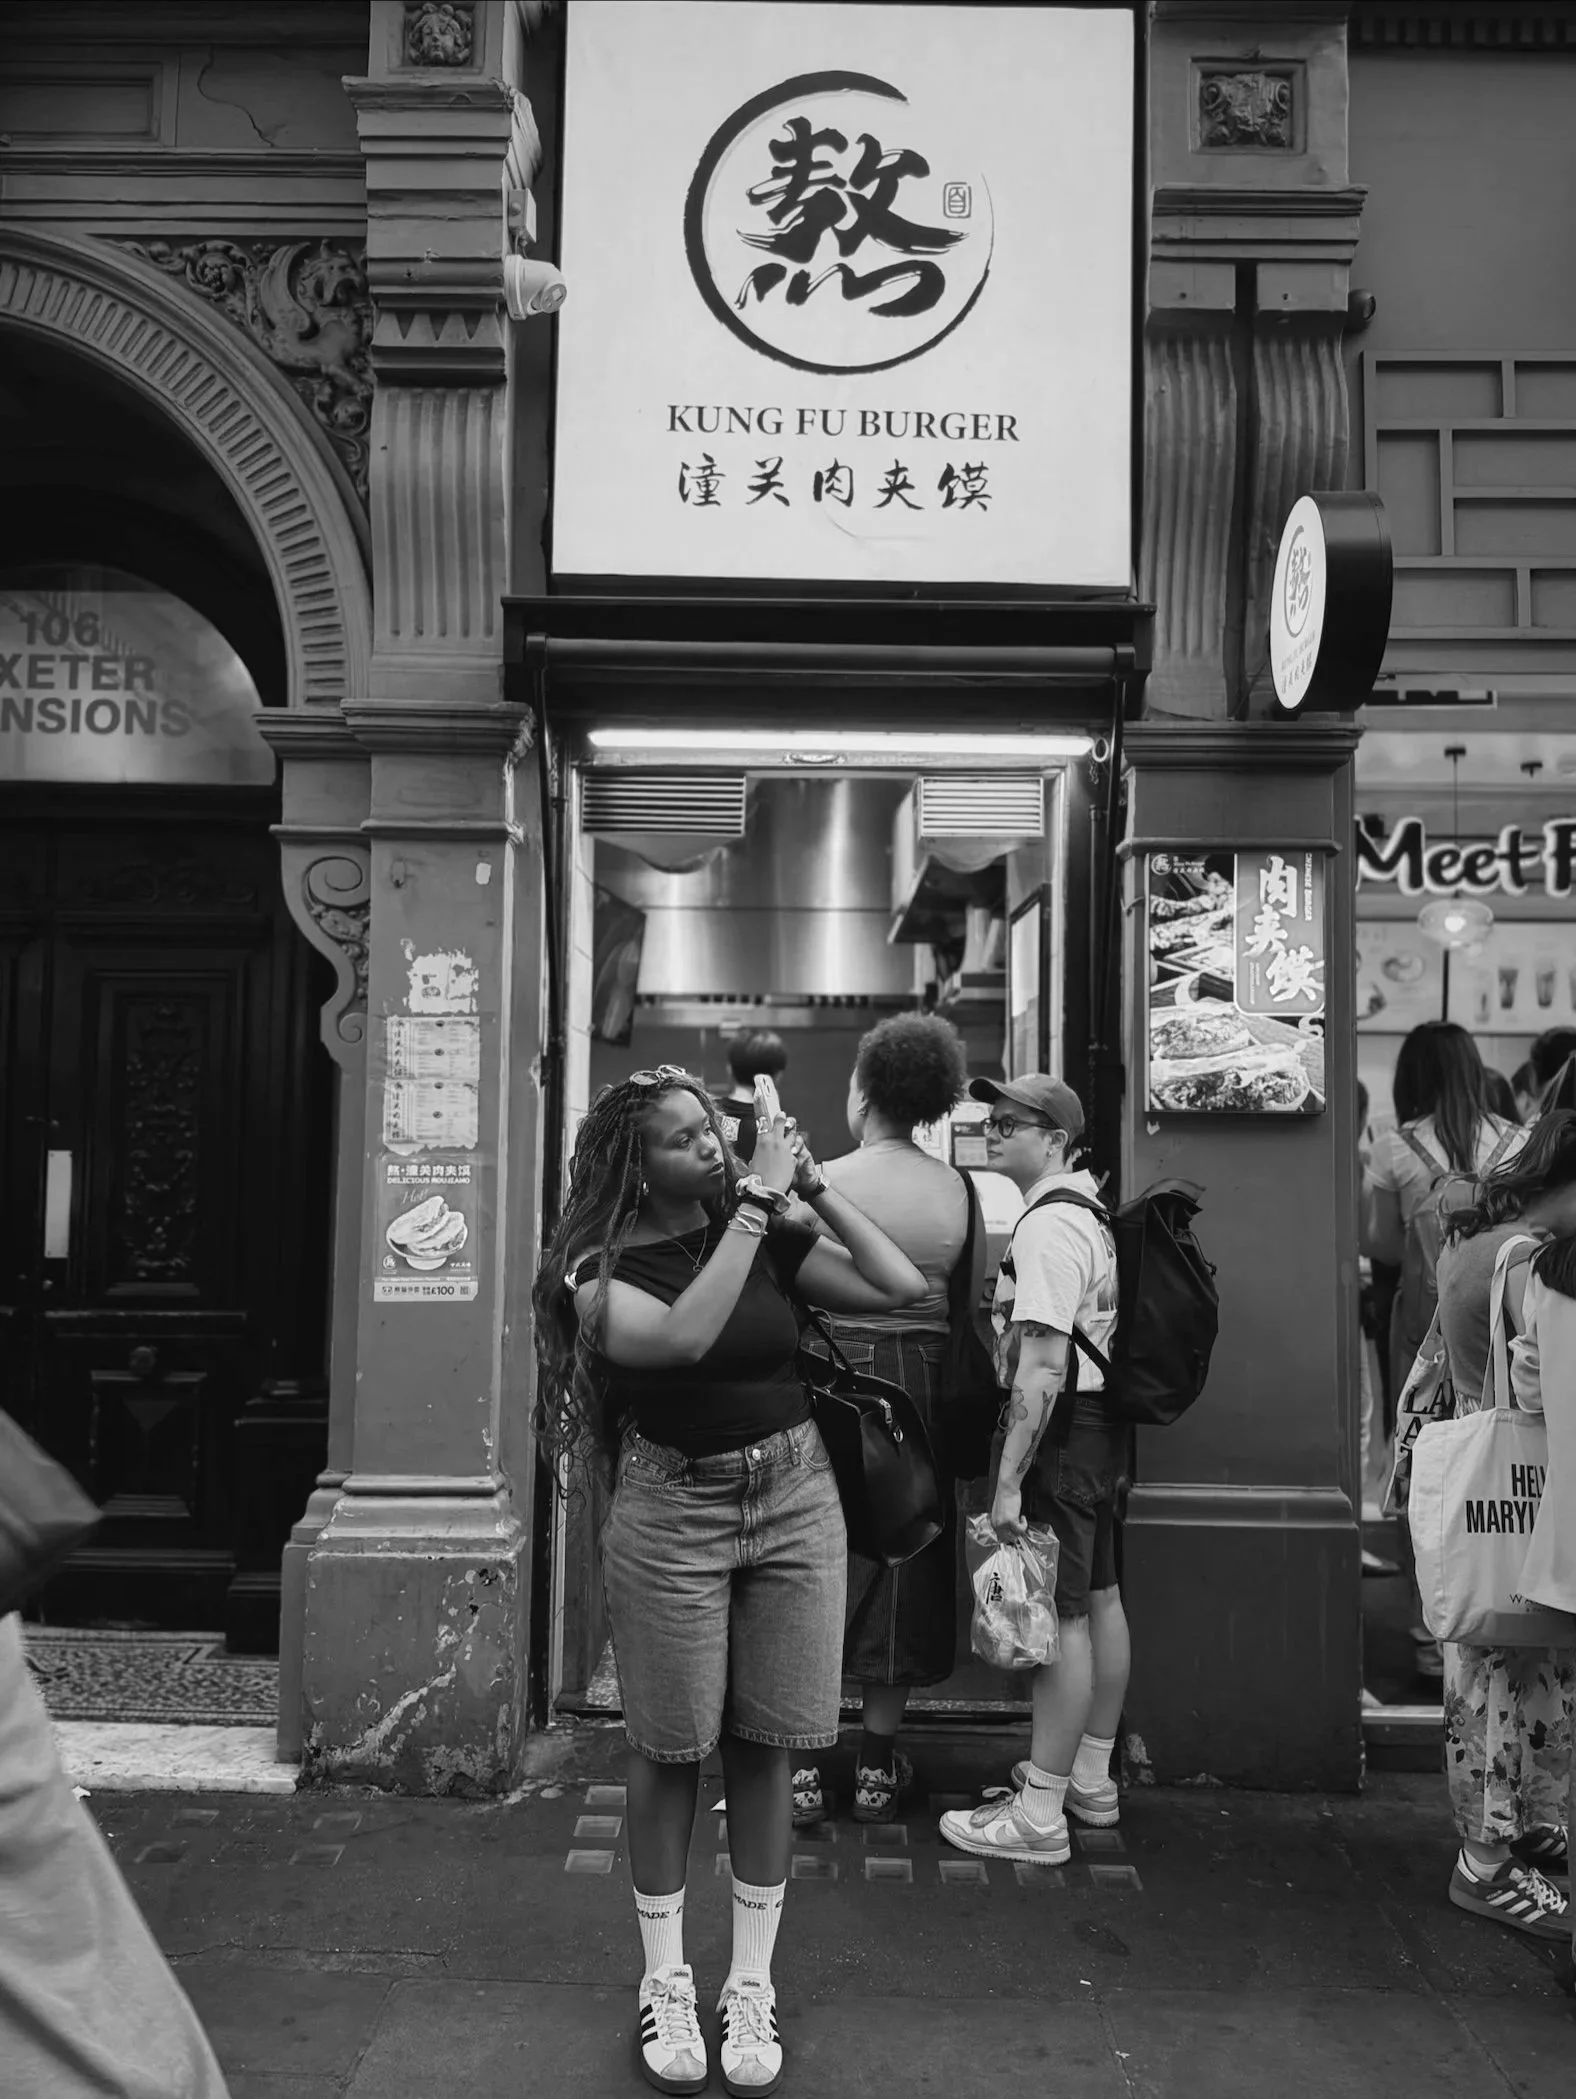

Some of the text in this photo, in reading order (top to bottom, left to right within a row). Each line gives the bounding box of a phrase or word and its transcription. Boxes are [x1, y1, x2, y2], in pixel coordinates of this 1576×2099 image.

[666, 404, 1020, 441] KUNG FU BURGER
[21, 611, 101, 647] 106
[0, 653, 156, 691] XETER
[1, 697, 192, 737] NSIONS
[1355, 816, 1541, 895] Meet
[734, 1892, 768, 1911] MADE
